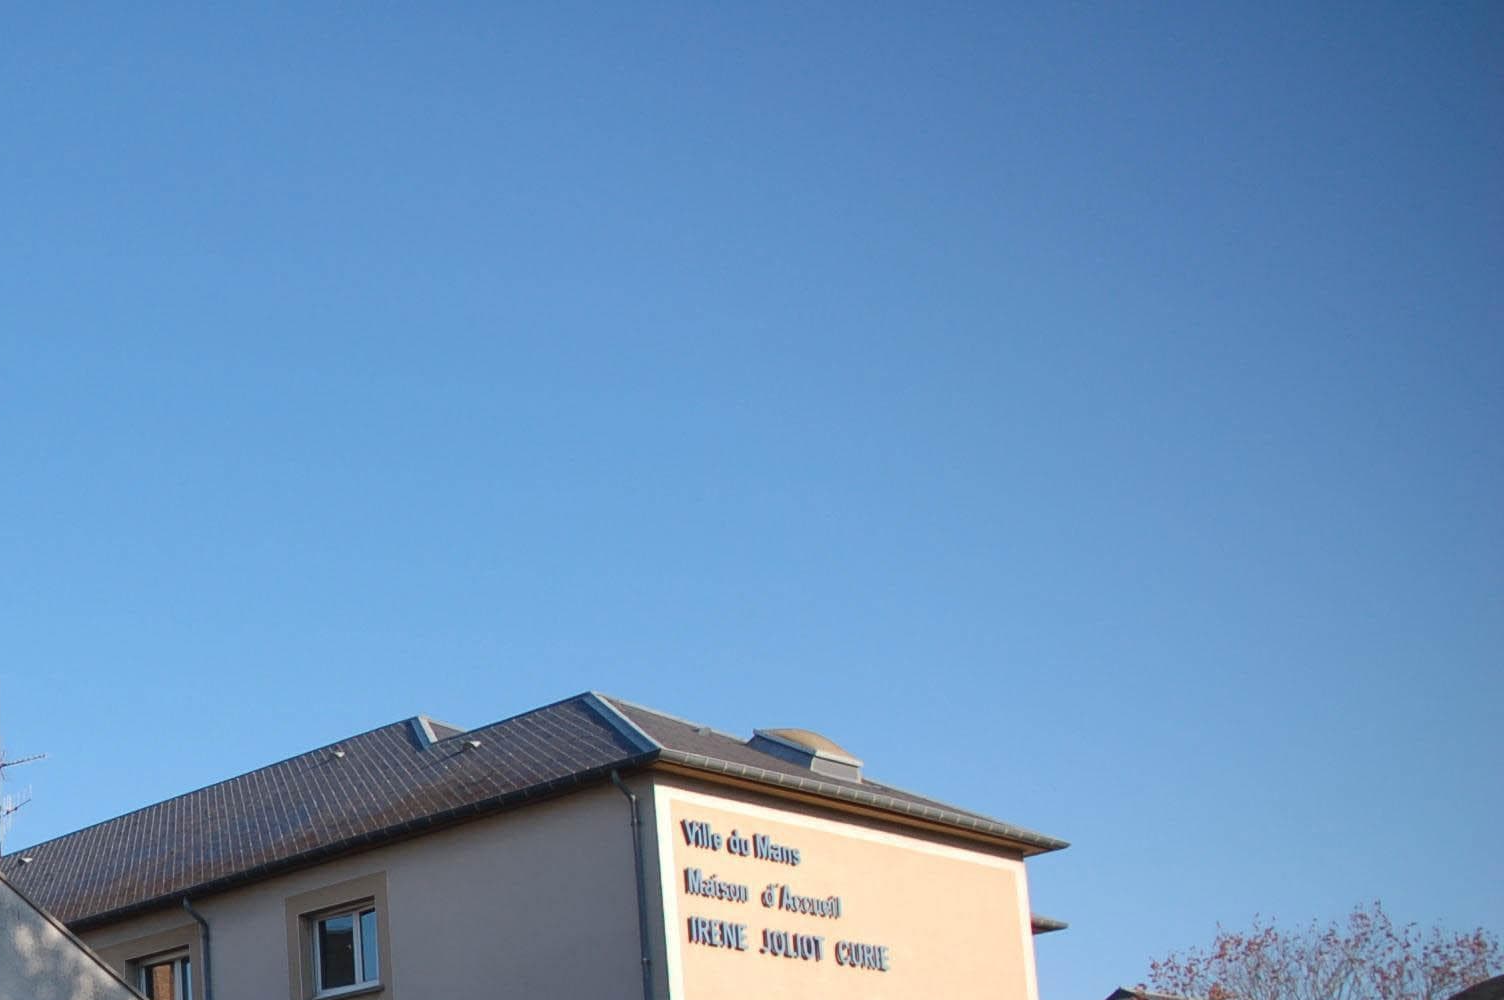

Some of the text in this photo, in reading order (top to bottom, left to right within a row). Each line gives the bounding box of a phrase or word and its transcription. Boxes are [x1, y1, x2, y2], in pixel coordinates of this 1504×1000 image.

[681, 819, 801, 866] Ville du Mans
[683, 867, 749, 904] Maison
[687, 915, 889, 972] IRENE JOLIOT CURIE
